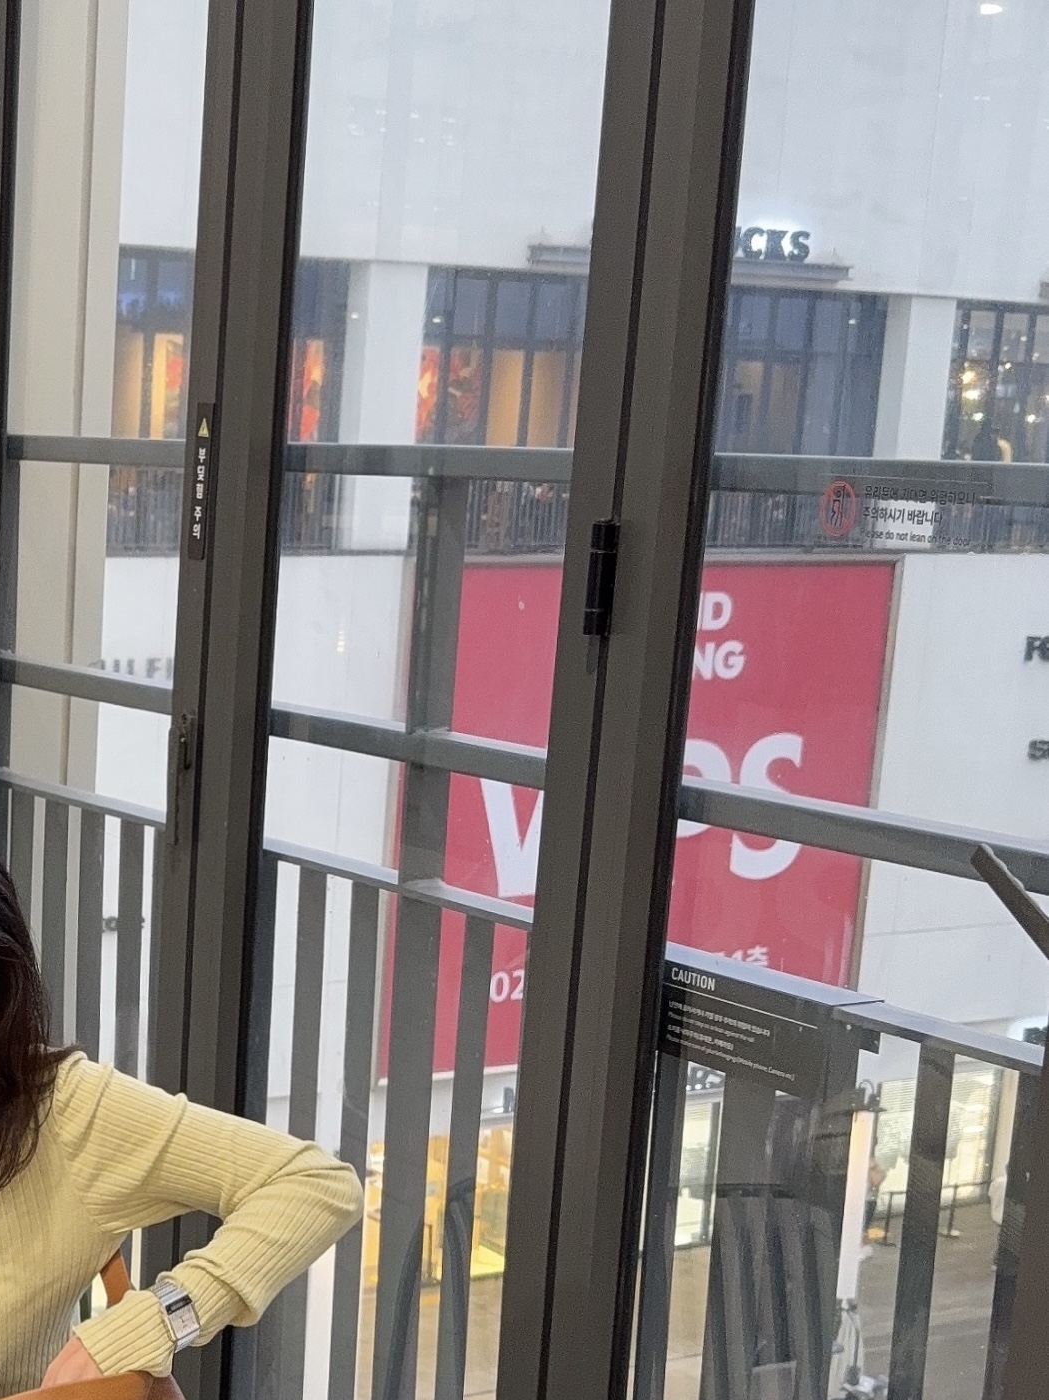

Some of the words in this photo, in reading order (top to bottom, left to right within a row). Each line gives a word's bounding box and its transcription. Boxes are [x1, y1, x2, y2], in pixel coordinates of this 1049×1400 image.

[195, 446, 206, 500] 부딪힘
[864, 485, 900, 502] 유리문에
[930, 489, 976, 507] 위험하오니
[192, 505, 202, 540] 주의
[862, 507, 905, 524] 주의하시기
[884, 529, 895, 541] do
[896, 531, 909, 542] not
[909, 531, 926, 544] lean
[927, 535, 937, 544] on
[692, 640, 746, 680] NG
[671, 966, 716, 992] CAUTION
